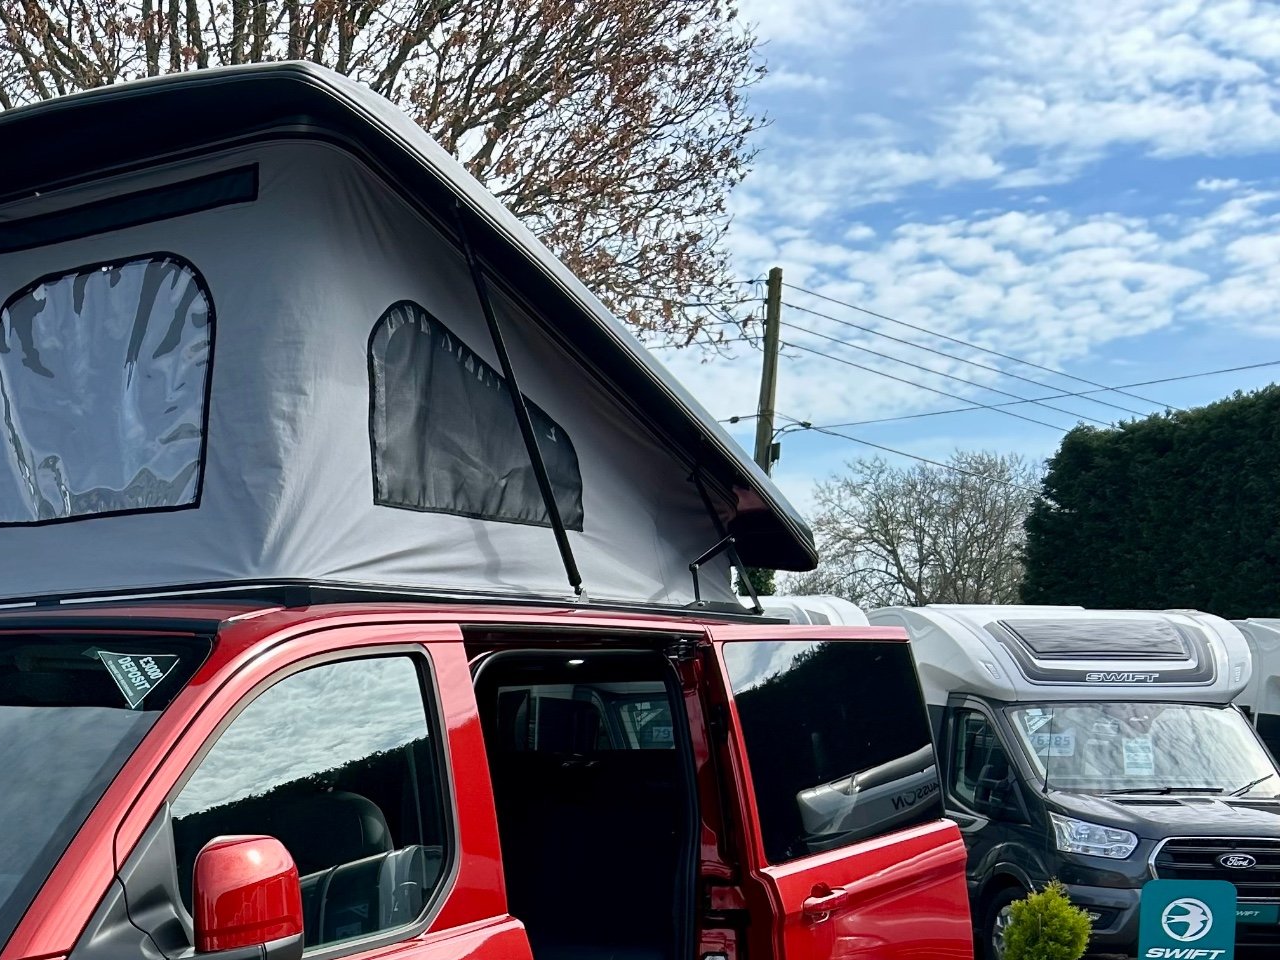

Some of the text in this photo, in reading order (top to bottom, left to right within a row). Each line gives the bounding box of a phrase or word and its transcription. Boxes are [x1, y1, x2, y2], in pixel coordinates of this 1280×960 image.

[117, 656, 151, 690] DEPOSIT
[138, 656, 164, 680] £3000
[1085, 672, 1160, 683] SWIFT
[1226, 856, 1250, 866] Ford
[1145, 948, 1226, 960] SWIFT
